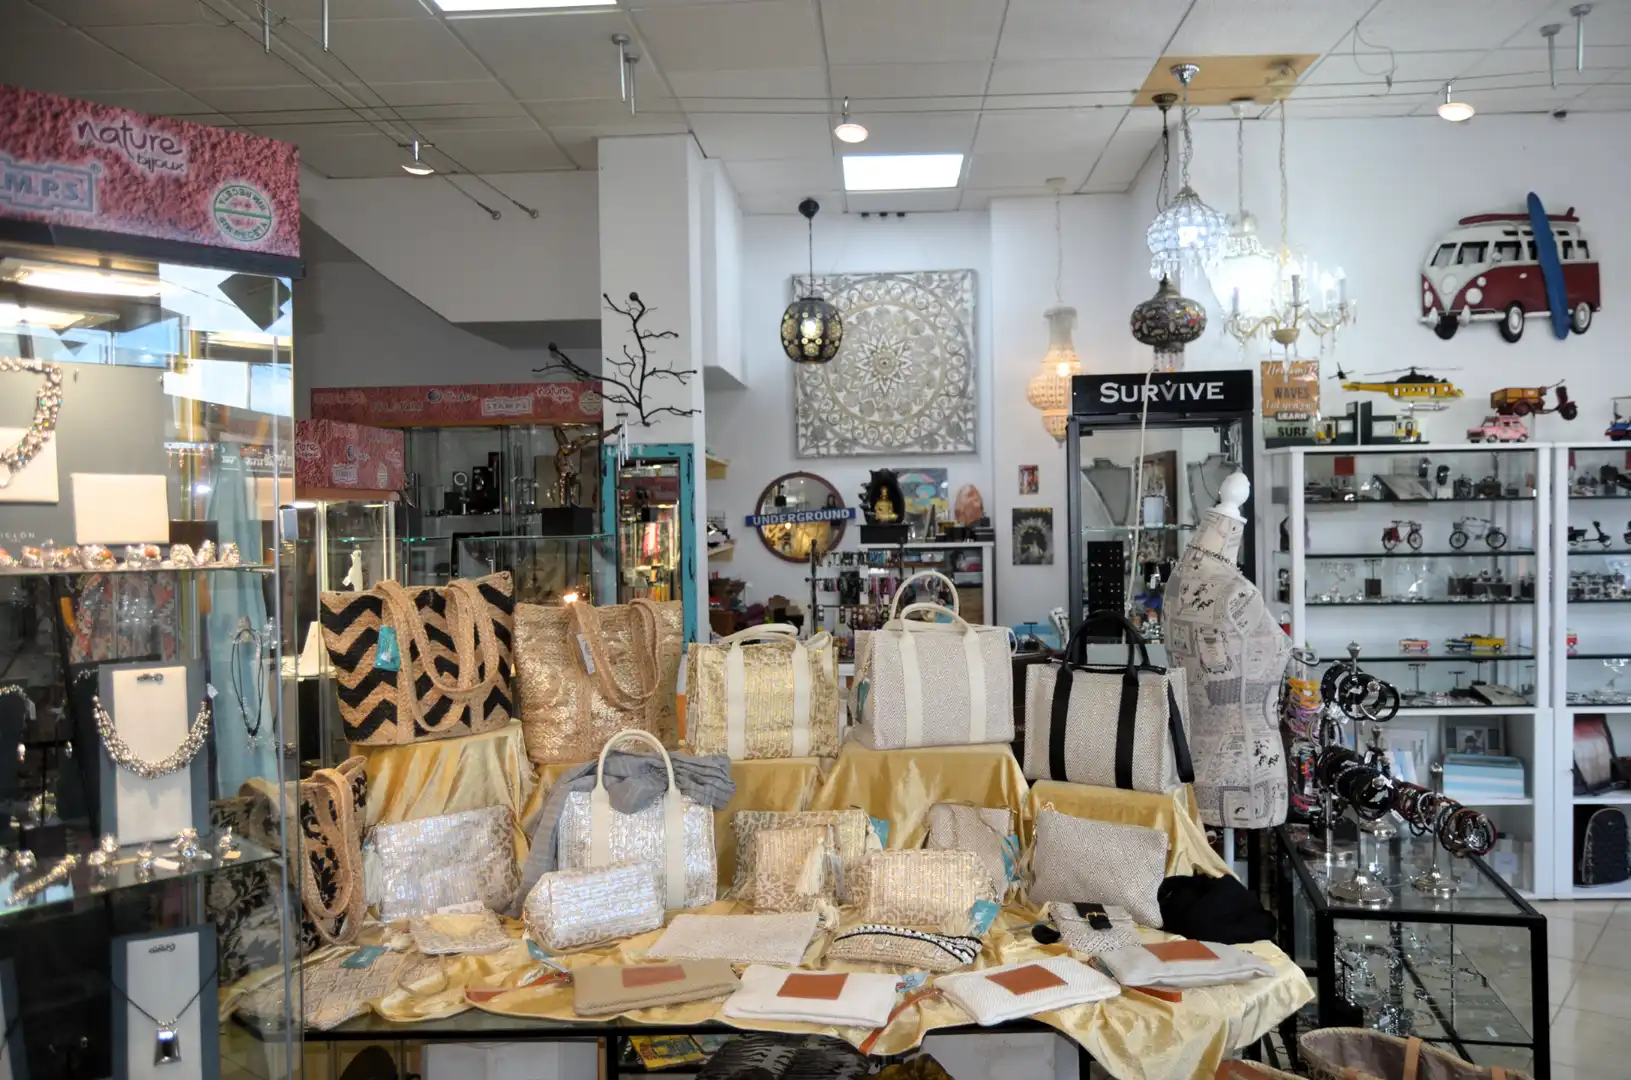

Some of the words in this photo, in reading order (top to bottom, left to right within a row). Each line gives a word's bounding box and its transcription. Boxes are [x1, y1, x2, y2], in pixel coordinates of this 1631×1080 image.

[1099, 380, 1225, 404] SURVIVE
[1273, 387, 1310, 399] WAVES
[1277, 411, 1308, 421] LEARN
[1277, 426, 1309, 438] SURF
[751, 508, 850, 526] UNDERGROUND
